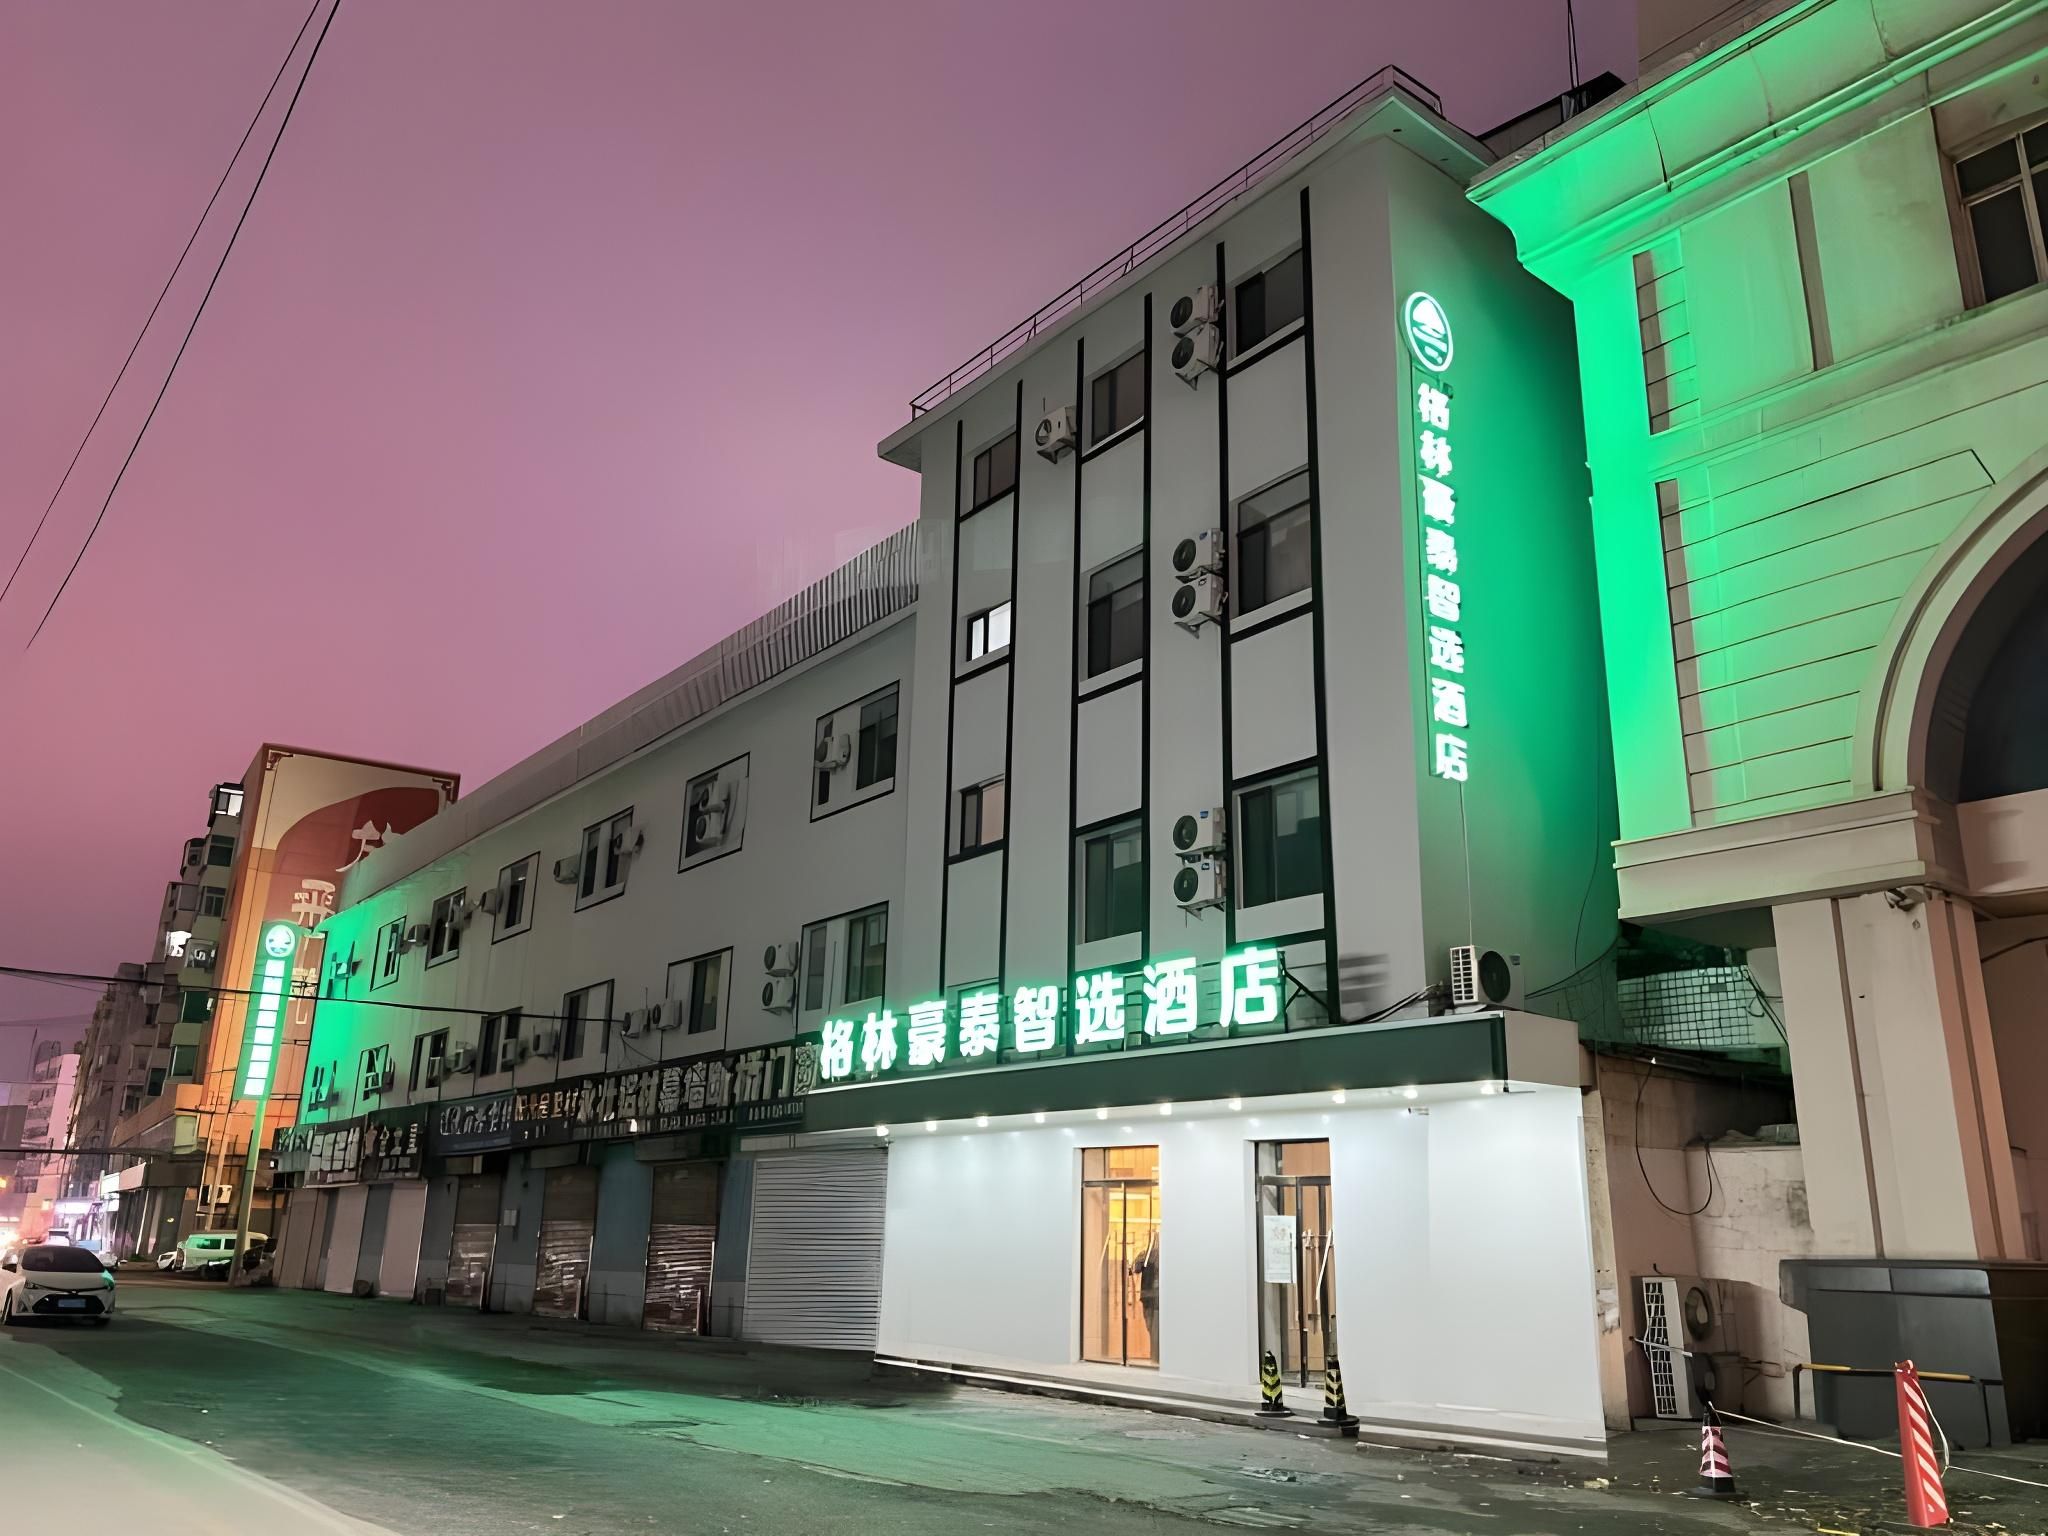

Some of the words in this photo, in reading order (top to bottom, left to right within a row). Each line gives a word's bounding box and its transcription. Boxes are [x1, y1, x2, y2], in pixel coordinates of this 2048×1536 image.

[820, 947, 1280, 1080] 格林豪泰智选酒店
